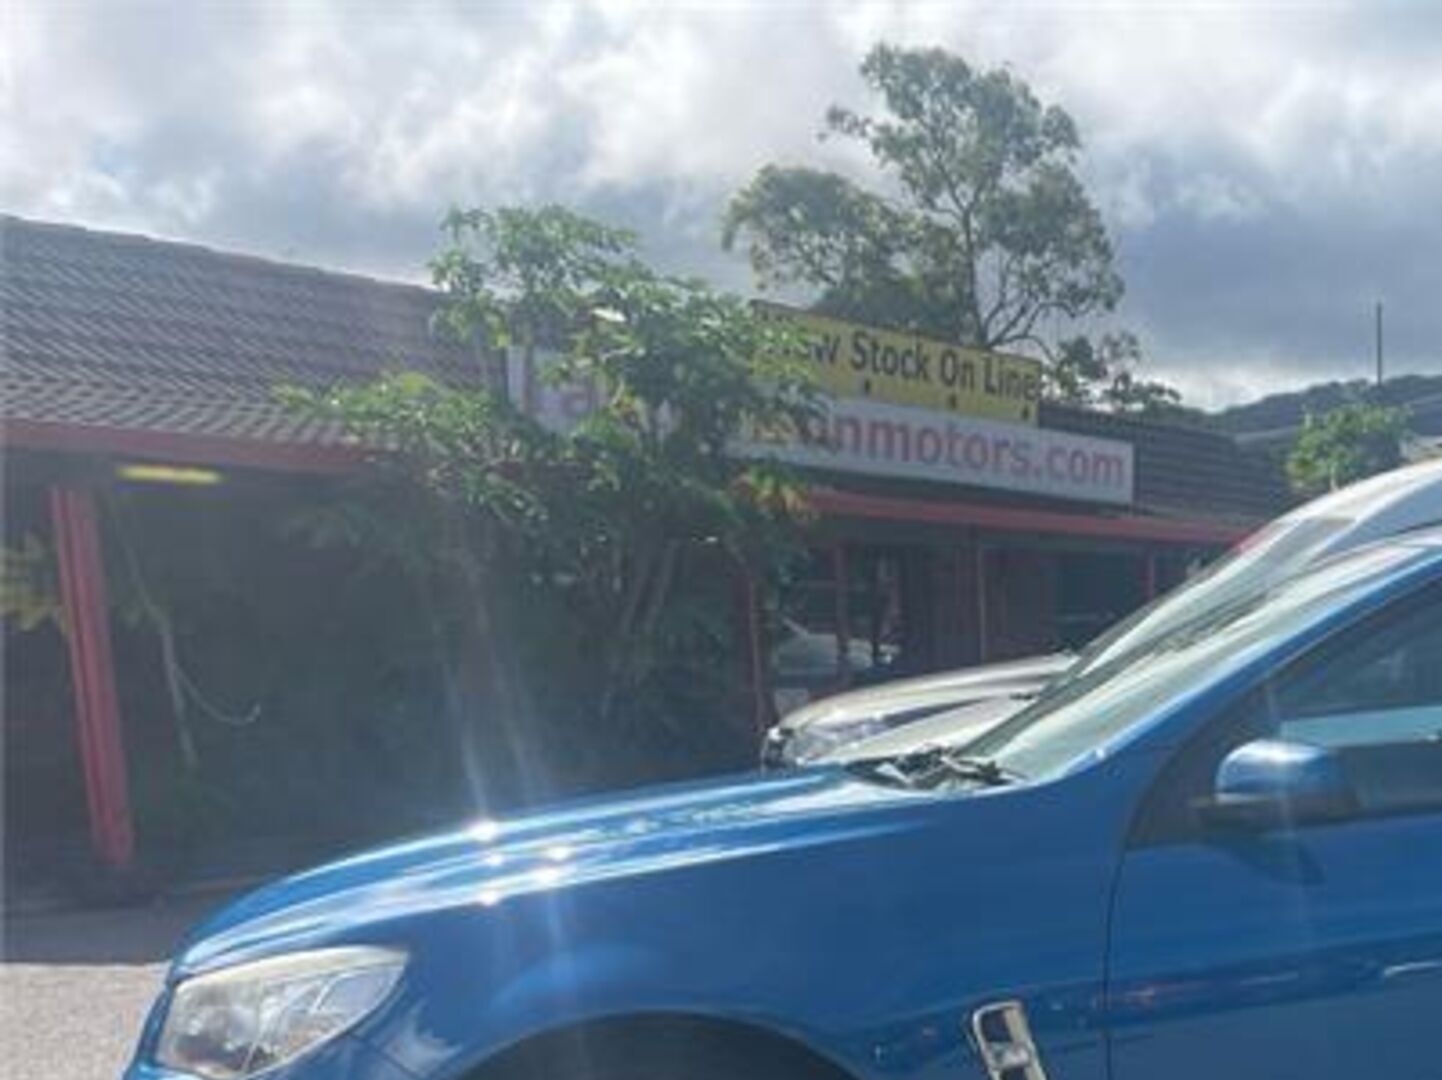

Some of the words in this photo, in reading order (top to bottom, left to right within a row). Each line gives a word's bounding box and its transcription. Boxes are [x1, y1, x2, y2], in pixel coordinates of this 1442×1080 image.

[849, 329, 929, 381] Stock
[940, 349, 975, 391] On
[983, 355, 1042, 402] Line
